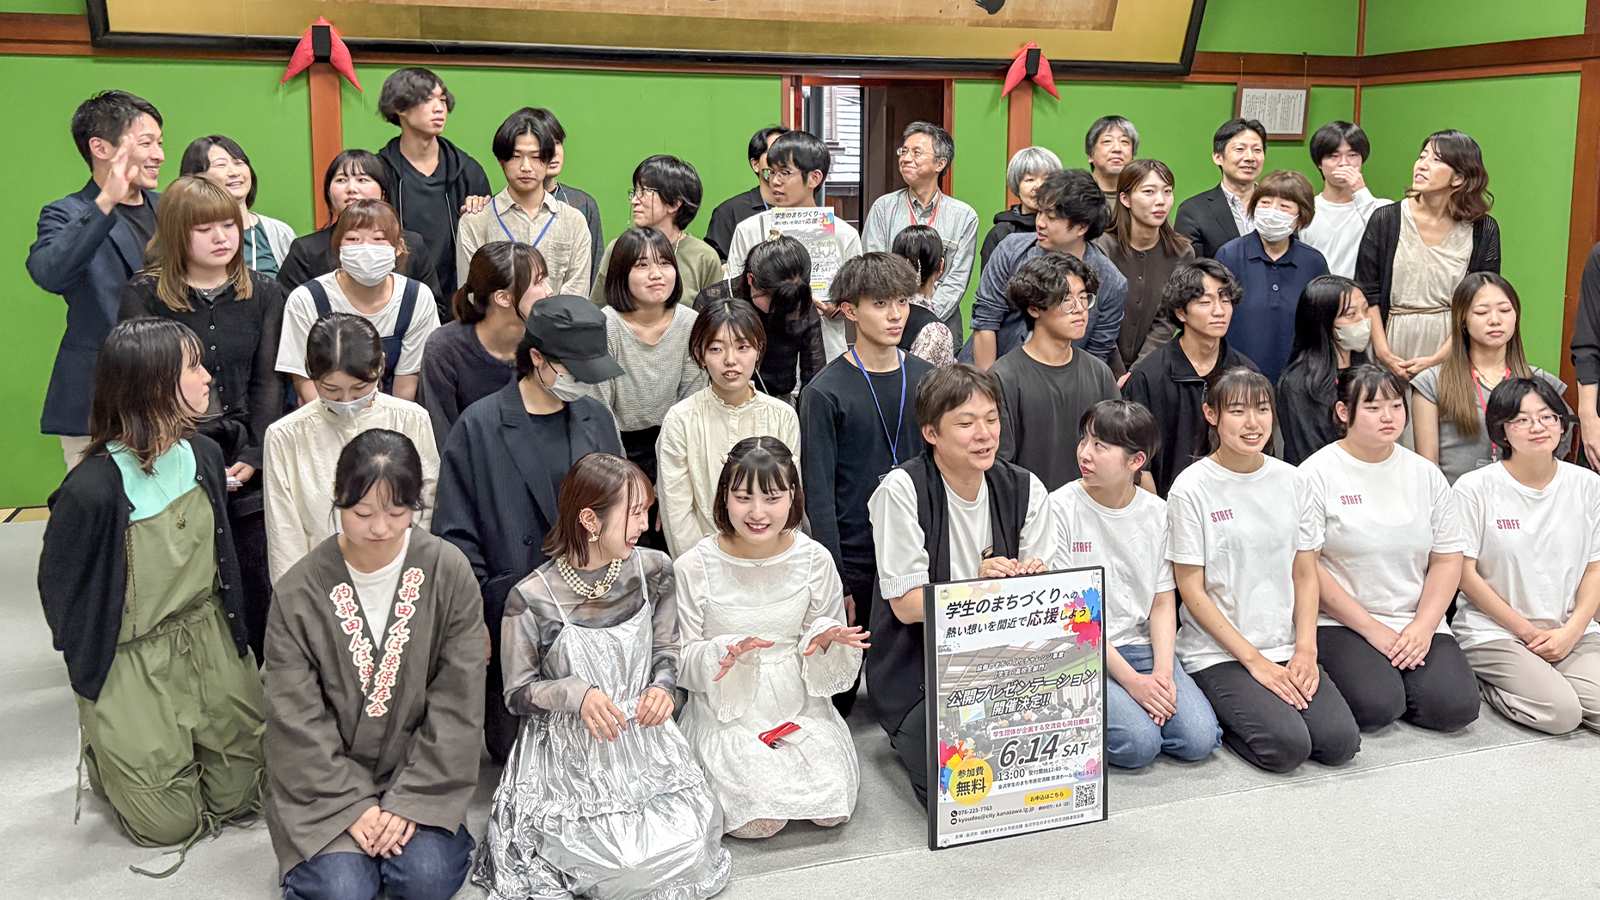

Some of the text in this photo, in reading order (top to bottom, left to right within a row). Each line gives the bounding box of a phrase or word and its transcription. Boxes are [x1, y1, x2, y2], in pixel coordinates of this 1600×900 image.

[1340, 494, 1363, 506] STAFF
[1211, 508, 1234, 523] STAFF
[1496, 518, 1520, 530] STAFF
[1072, 541, 1092, 553] STAFF
[945, 587, 1078, 620] 学生のまちづくりへの
[331, 584, 374, 692] 釣部田んぼ染
[367, 569, 423, 716] 釣部田んぼ染保存会
[947, 669, 1098, 708] 公開プレゼンテーション
[1000, 734, 1089, 768] 6.14 SAT
[957, 766, 984, 780] 参加費
[998, 768, 1025, 782] 13:00
[956, 778, 987, 797] 無料
[958, 805, 993, 816] 076-225-7763
